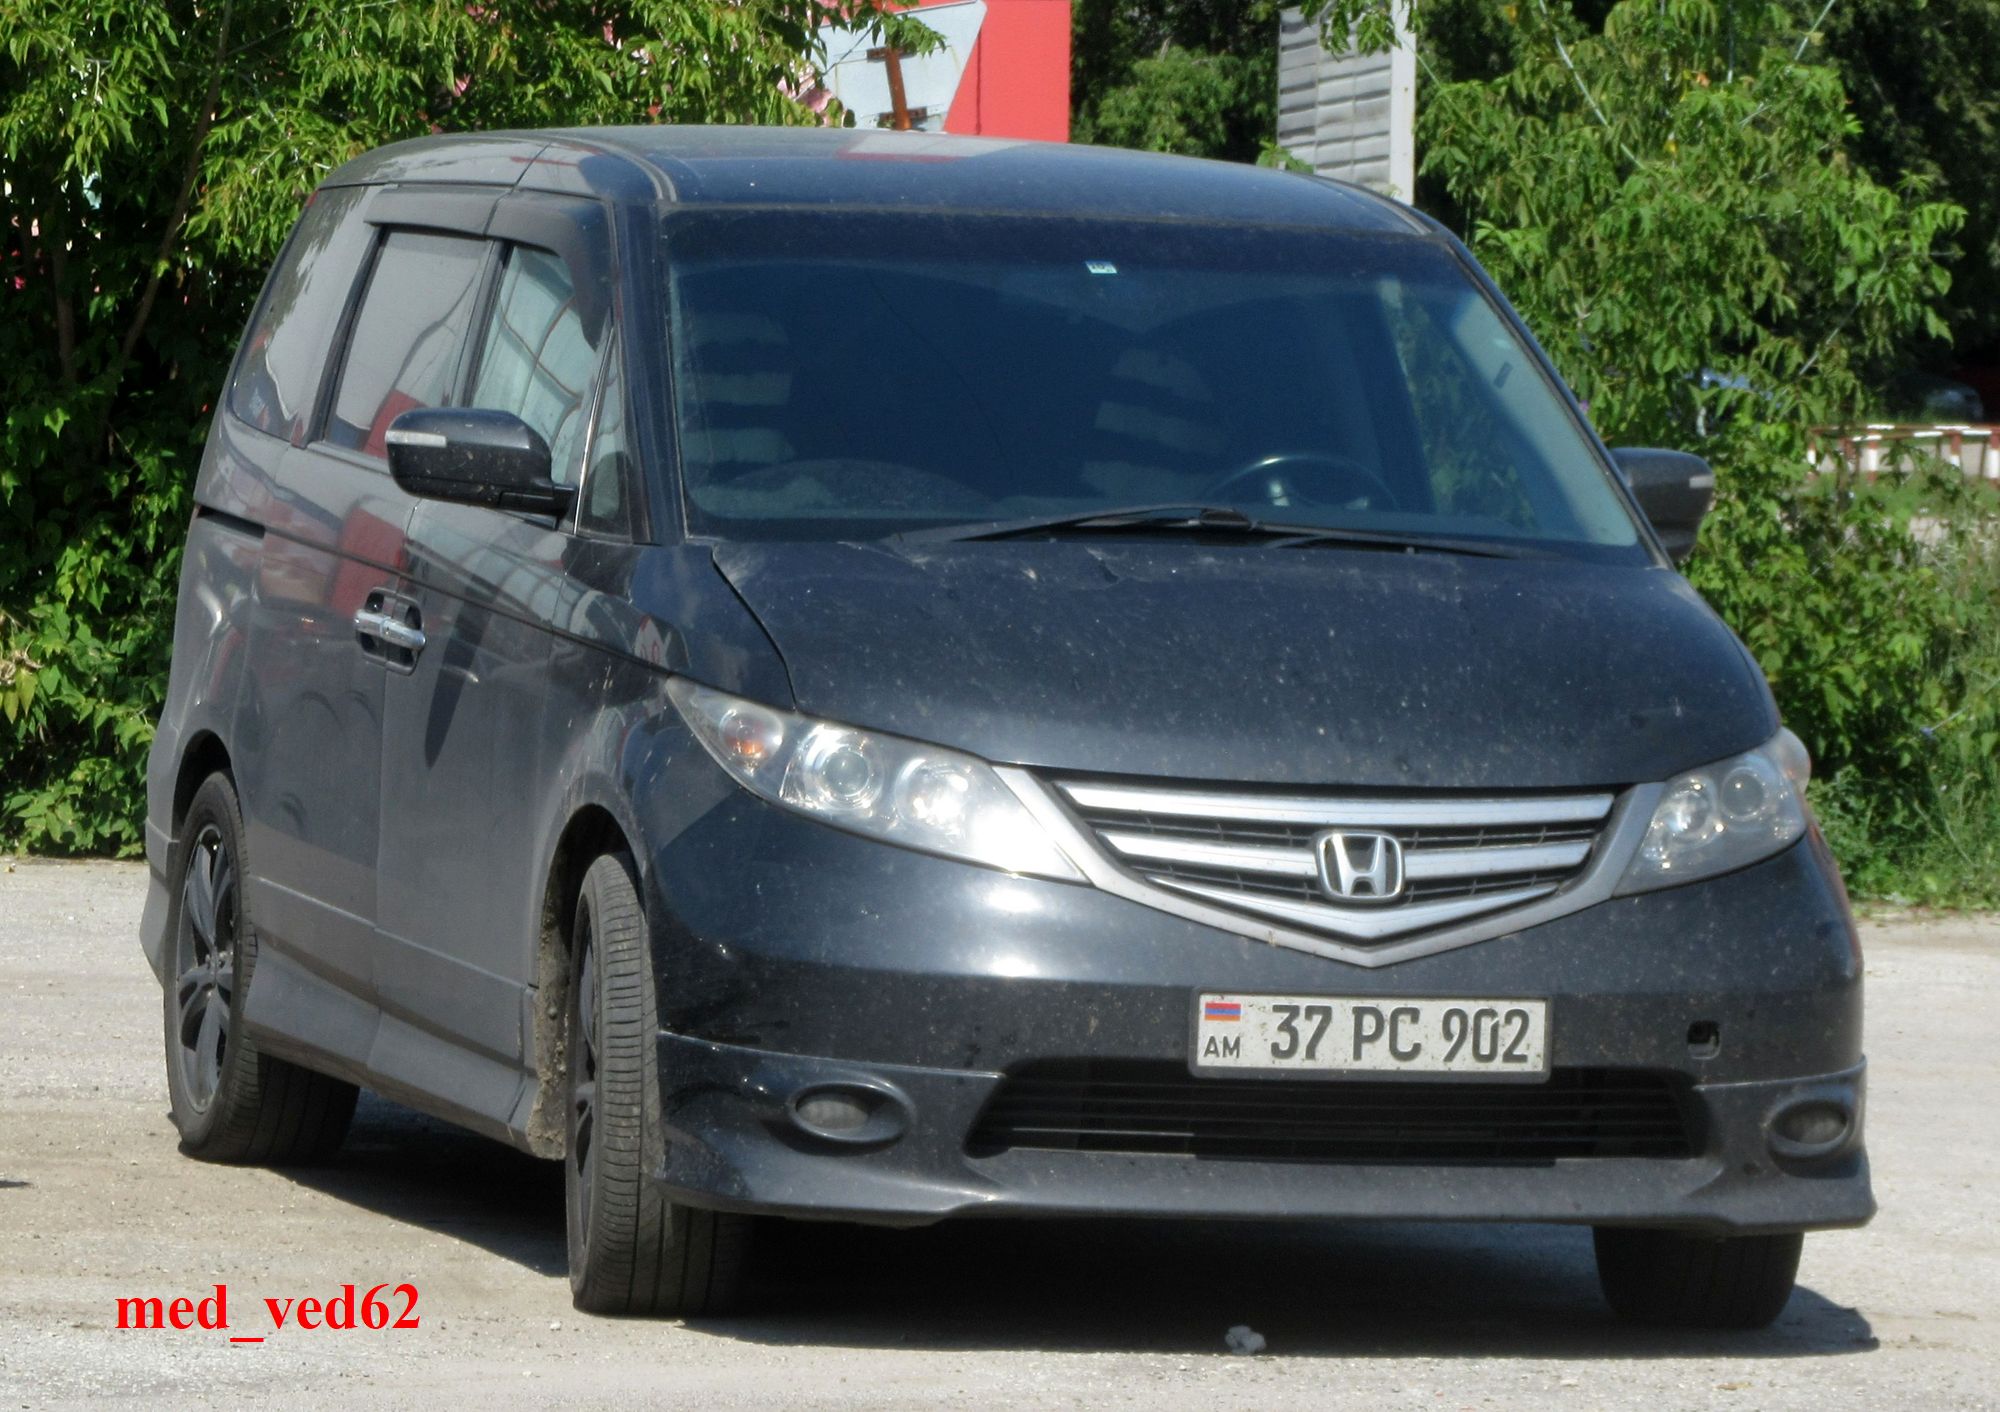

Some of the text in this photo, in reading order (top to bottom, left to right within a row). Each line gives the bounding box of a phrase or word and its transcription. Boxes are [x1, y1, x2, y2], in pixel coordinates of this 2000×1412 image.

[1203, 1035, 1241, 1060] AM
[1270, 1004, 1530, 1063] 37 PC 902
